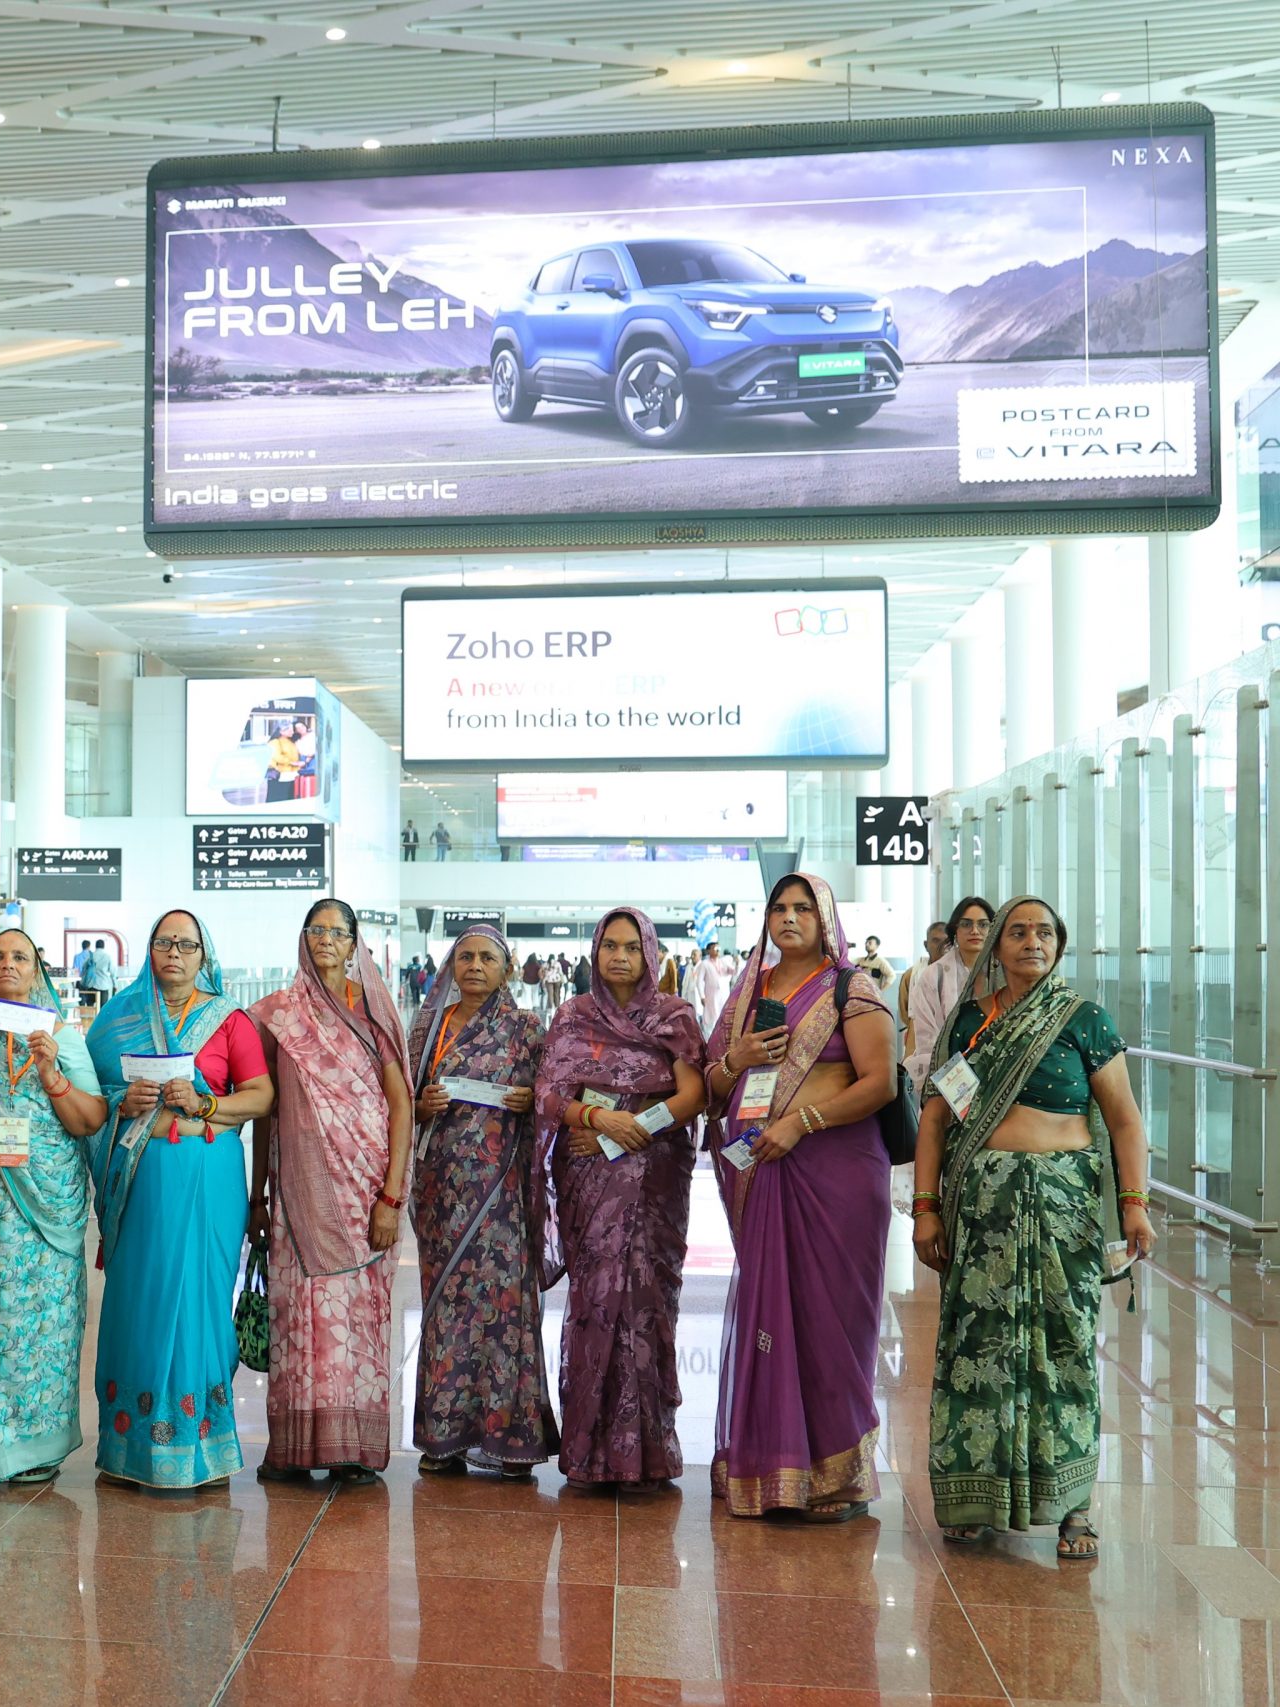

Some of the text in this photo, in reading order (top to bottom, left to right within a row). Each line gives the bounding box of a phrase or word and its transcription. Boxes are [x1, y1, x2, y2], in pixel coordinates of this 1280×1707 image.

[1110, 146, 1193, 166] NEXA
[183, 261, 403, 301] JULLEY
[183, 299, 475, 339] FROM LEH
[812, 359, 862, 369] VITARA
[1002, 405, 1150, 422] POSTCARD
[1049, 427, 1103, 437] FROM
[1007, 441, 1178, 458] VITARA
[164, 479, 458, 508] India goes electric
[446, 630, 613, 660] Zoho ERP
[447, 678, 463, 697] A
[472, 681, 526, 697] new
[616, 674, 667, 695] ERP
[447, 705, 742, 728] from India to the world
[898, 801, 924, 827] A
[249, 826, 308, 839] A16-A20
[62, 850, 109, 860] A40-A44
[249, 848, 308, 861] A40-A44
[865, 833, 925, 861] 14b
[724, 904, 735, 915] A
